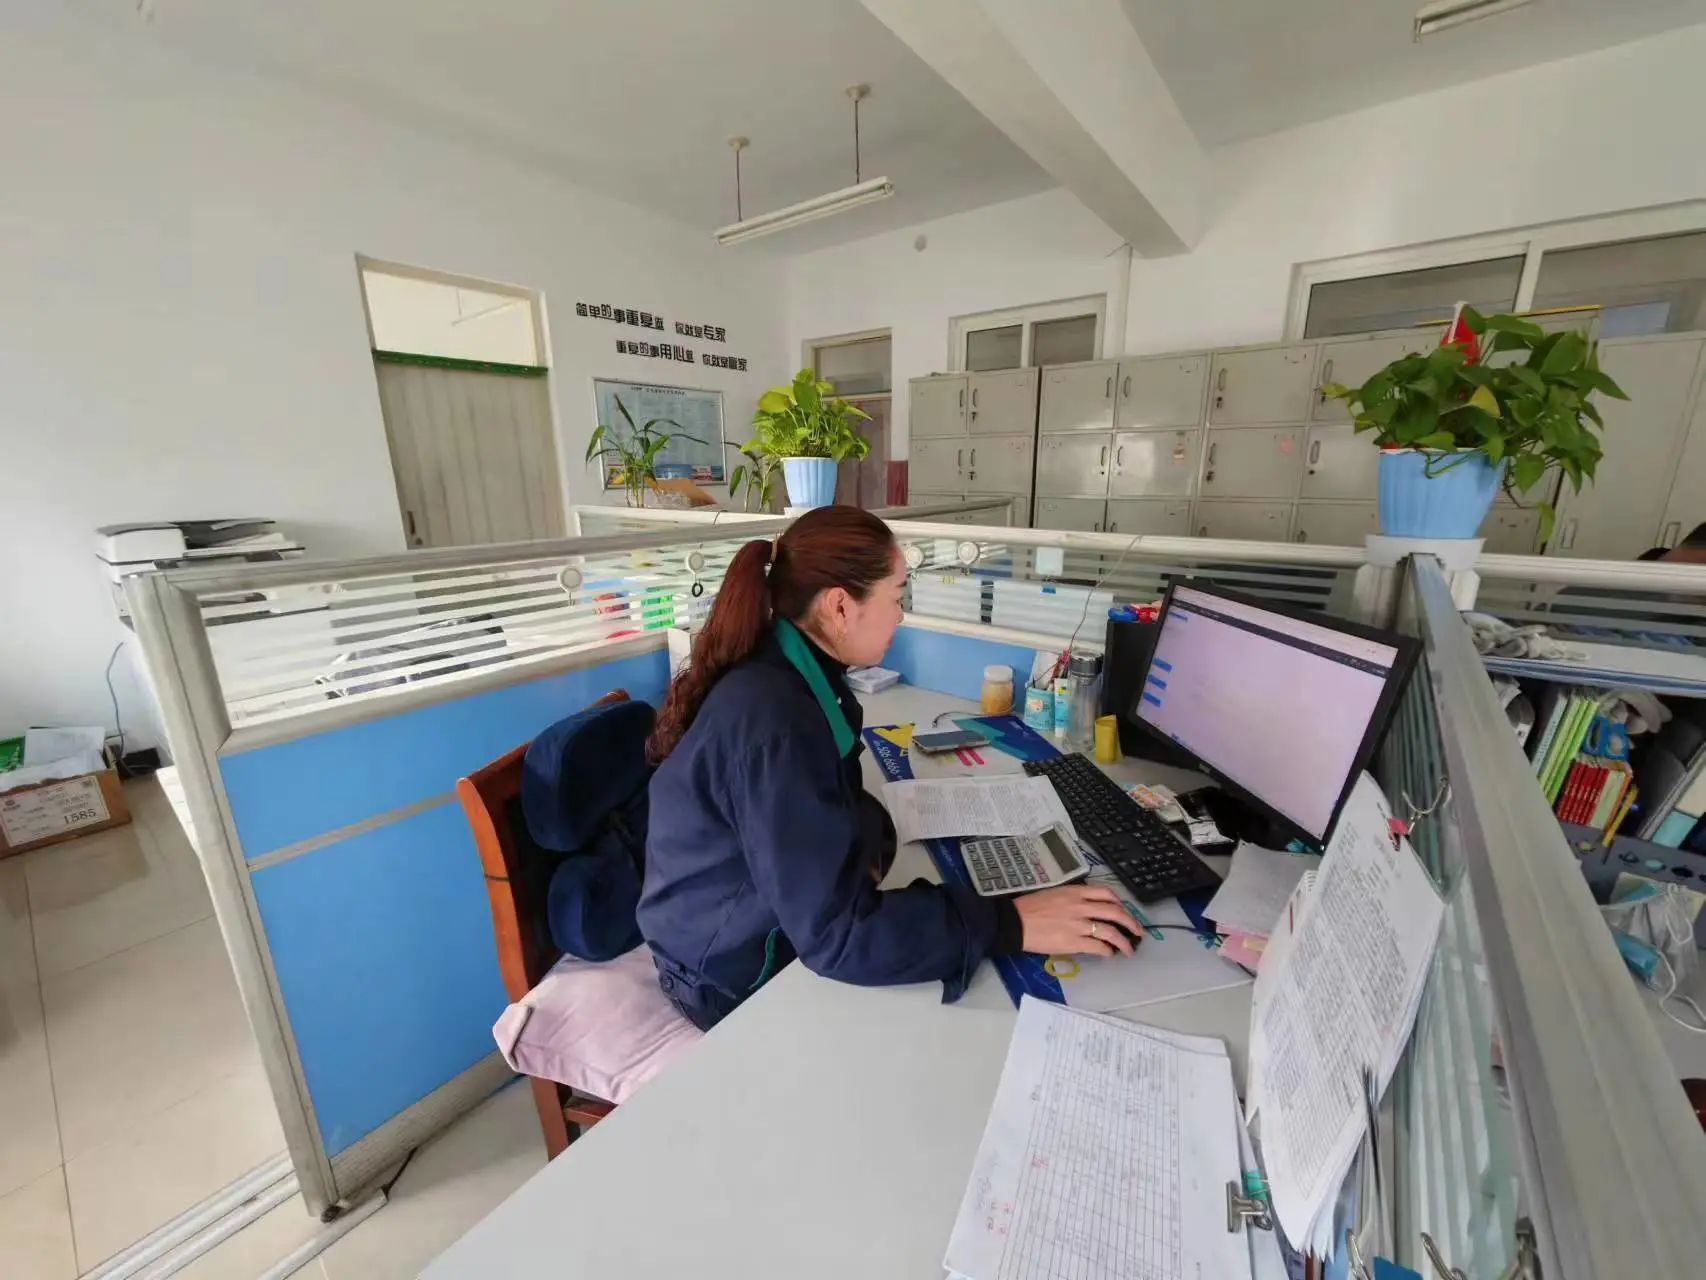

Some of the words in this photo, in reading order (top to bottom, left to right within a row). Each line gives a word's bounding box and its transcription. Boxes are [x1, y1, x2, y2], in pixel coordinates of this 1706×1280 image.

[675, 321, 726, 343] 你就是专家
[64, 808, 97, 825] 1585
